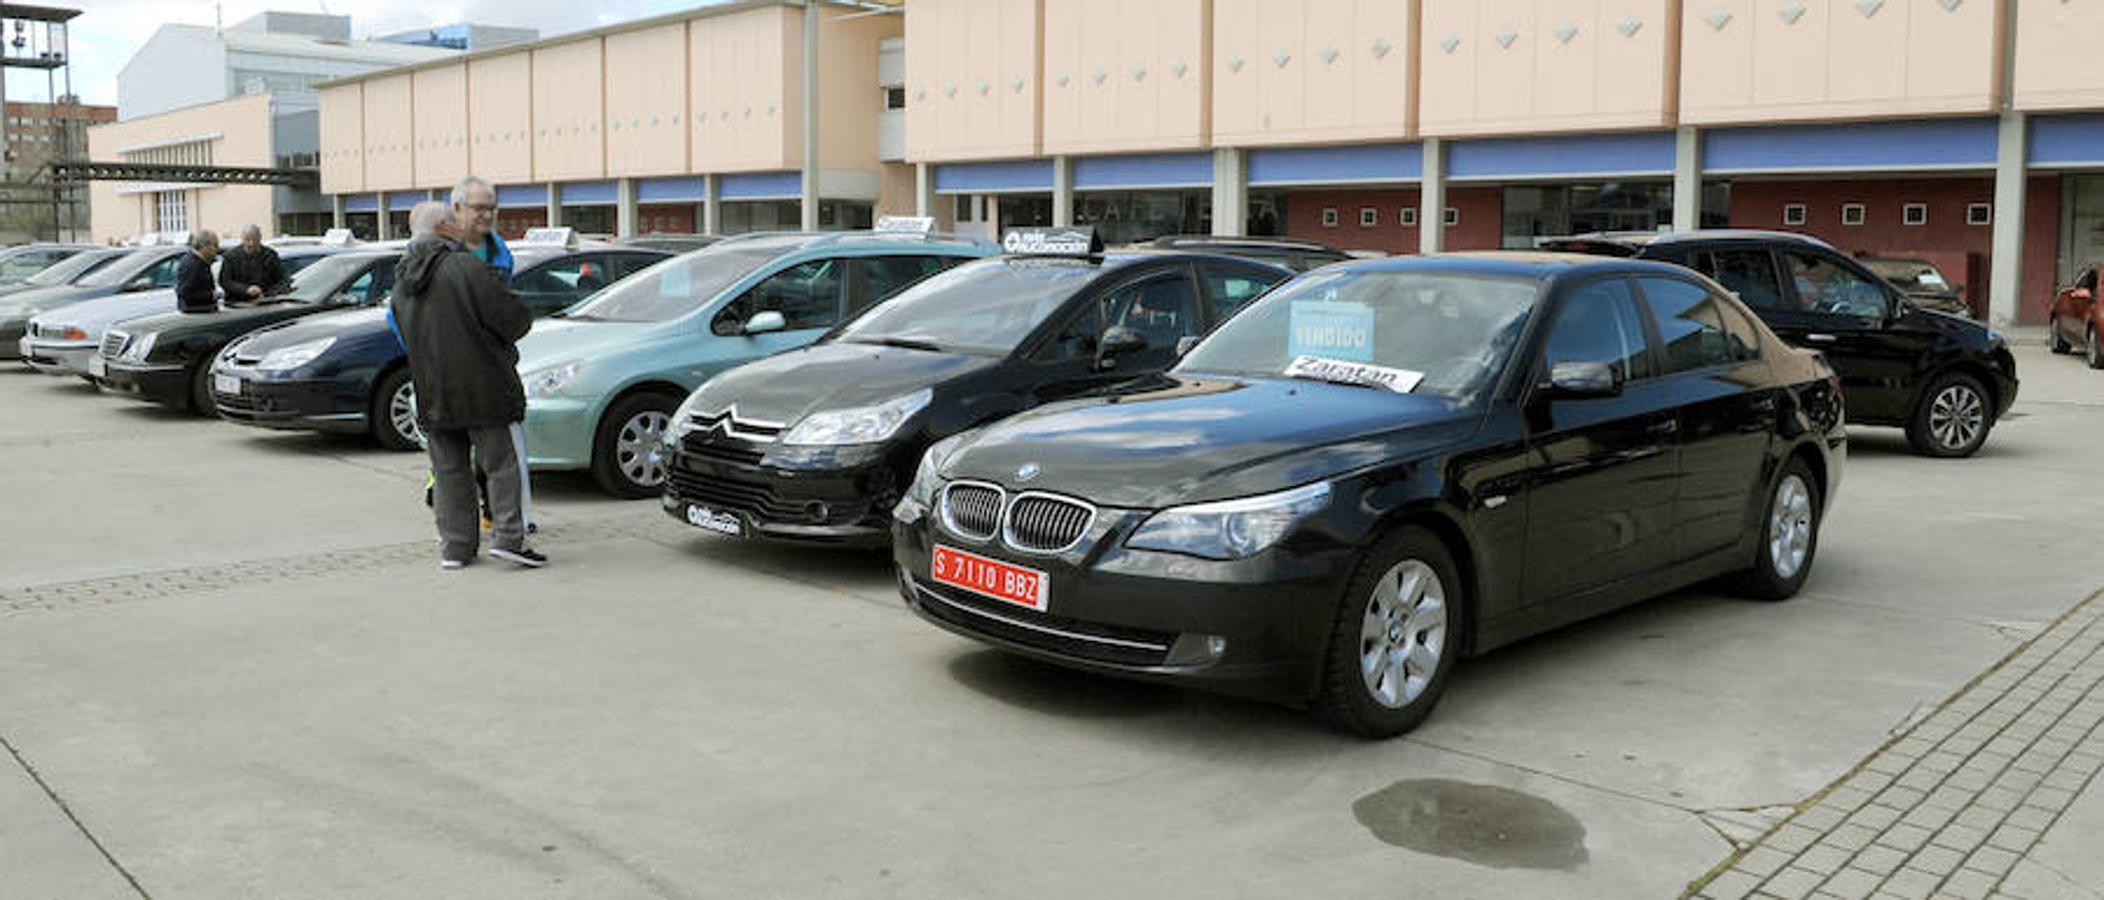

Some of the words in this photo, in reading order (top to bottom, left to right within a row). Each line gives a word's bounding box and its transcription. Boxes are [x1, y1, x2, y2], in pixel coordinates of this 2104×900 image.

[1296, 326, 1366, 347] VENDIDO
[954, 558, 997, 589] 7110
[1005, 570, 1037, 600] BBZ
